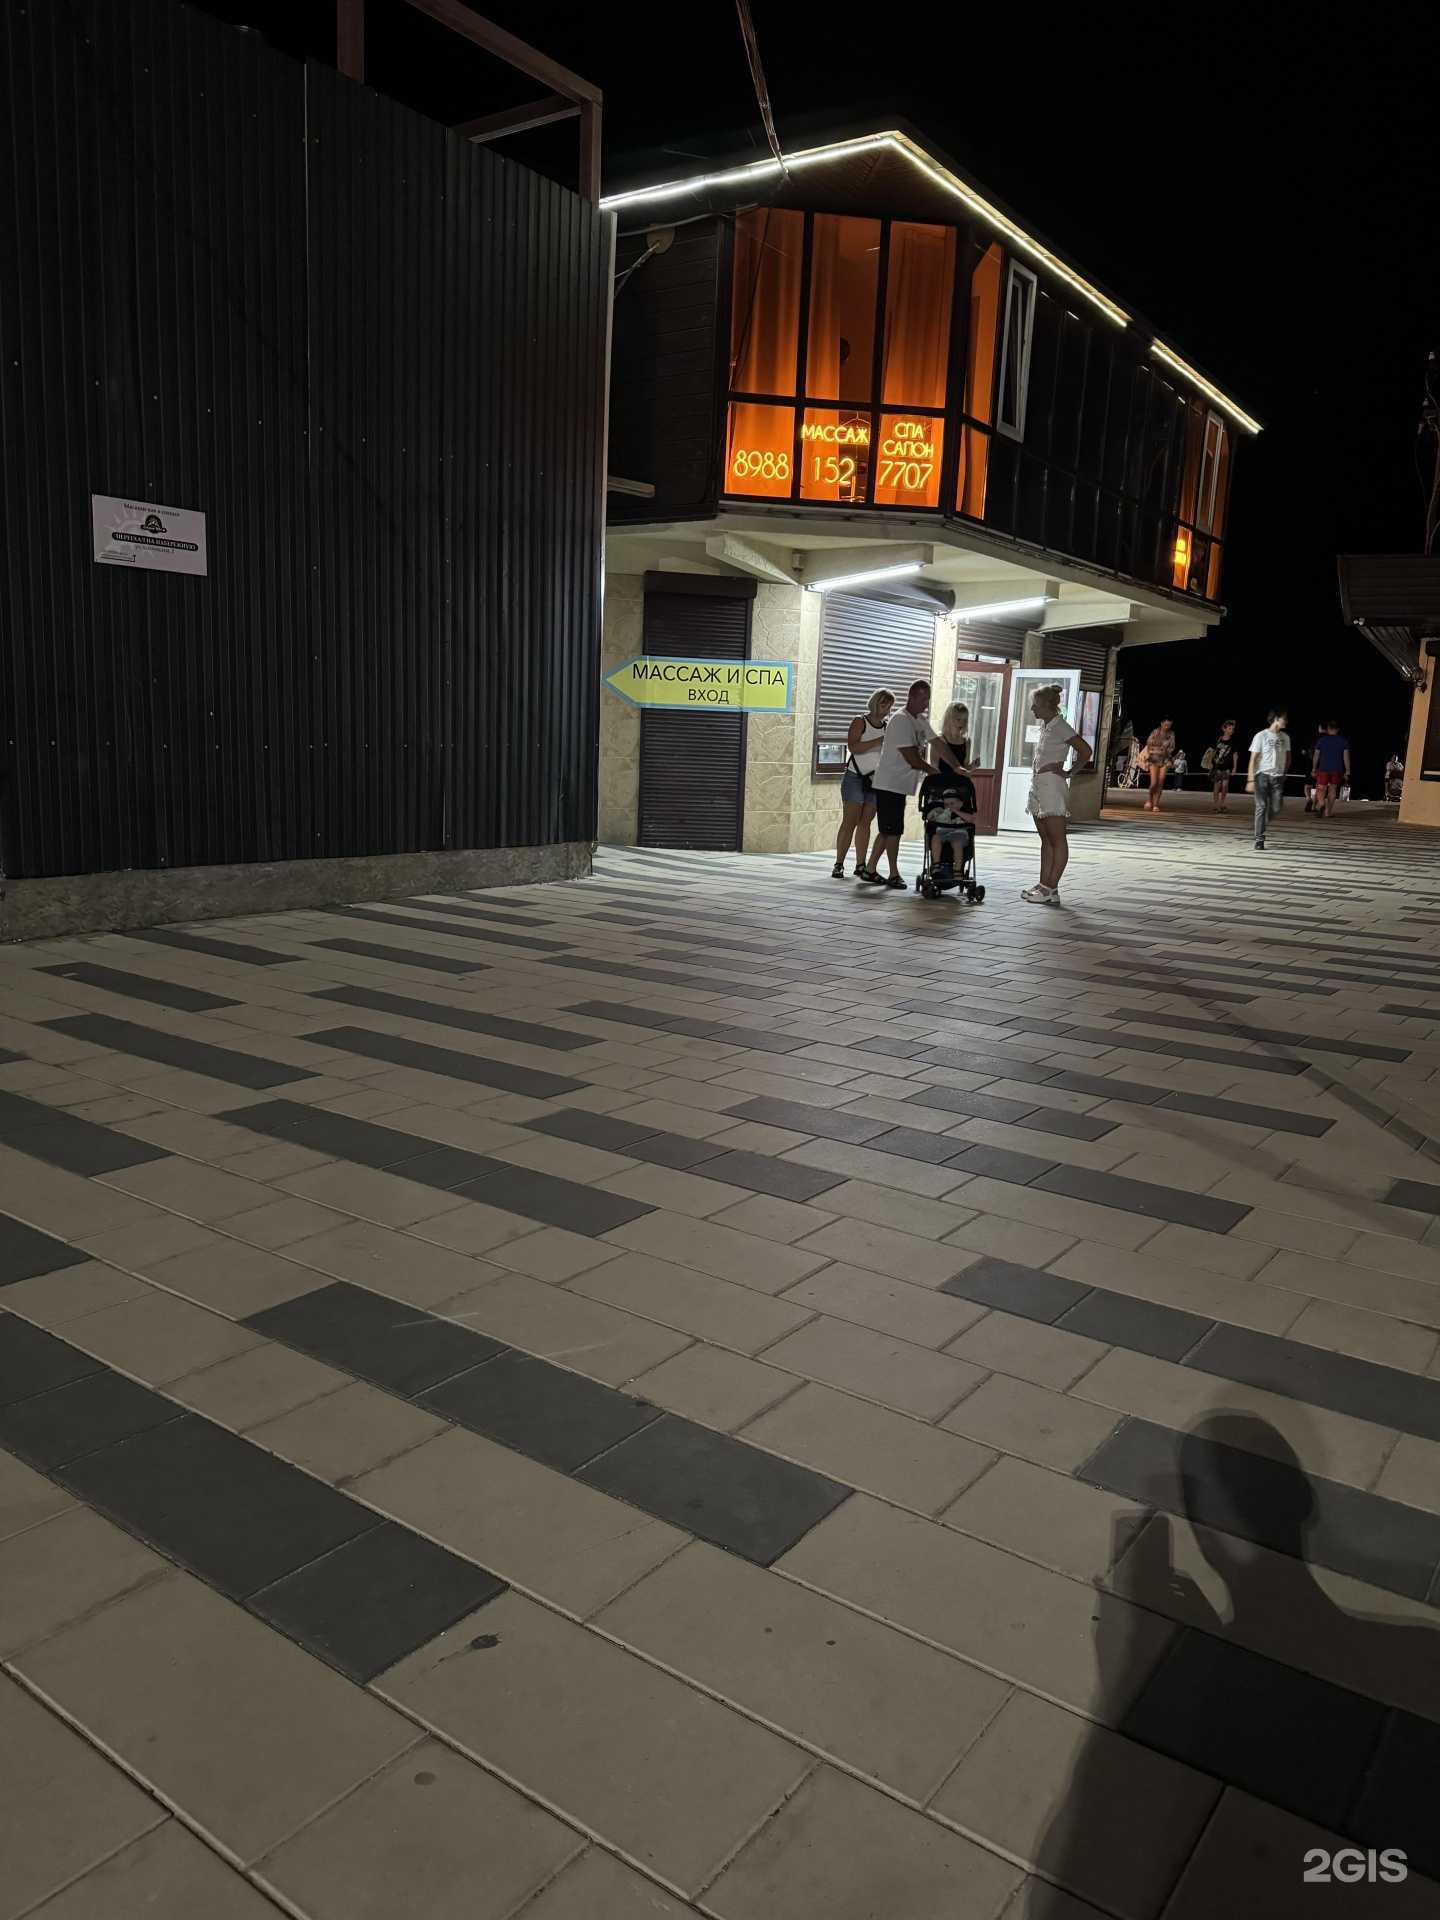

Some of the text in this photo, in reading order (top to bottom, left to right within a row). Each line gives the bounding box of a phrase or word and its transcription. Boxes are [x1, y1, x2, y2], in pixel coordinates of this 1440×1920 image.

[801, 424, 869, 444] МАССАЖ
[894, 422, 924, 439] СПА
[734, 450, 934, 489] 8988 152 7707
[632, 663, 785, 686] МАССАЖ И СПА
[688, 688, 730, 704] ВХОД
